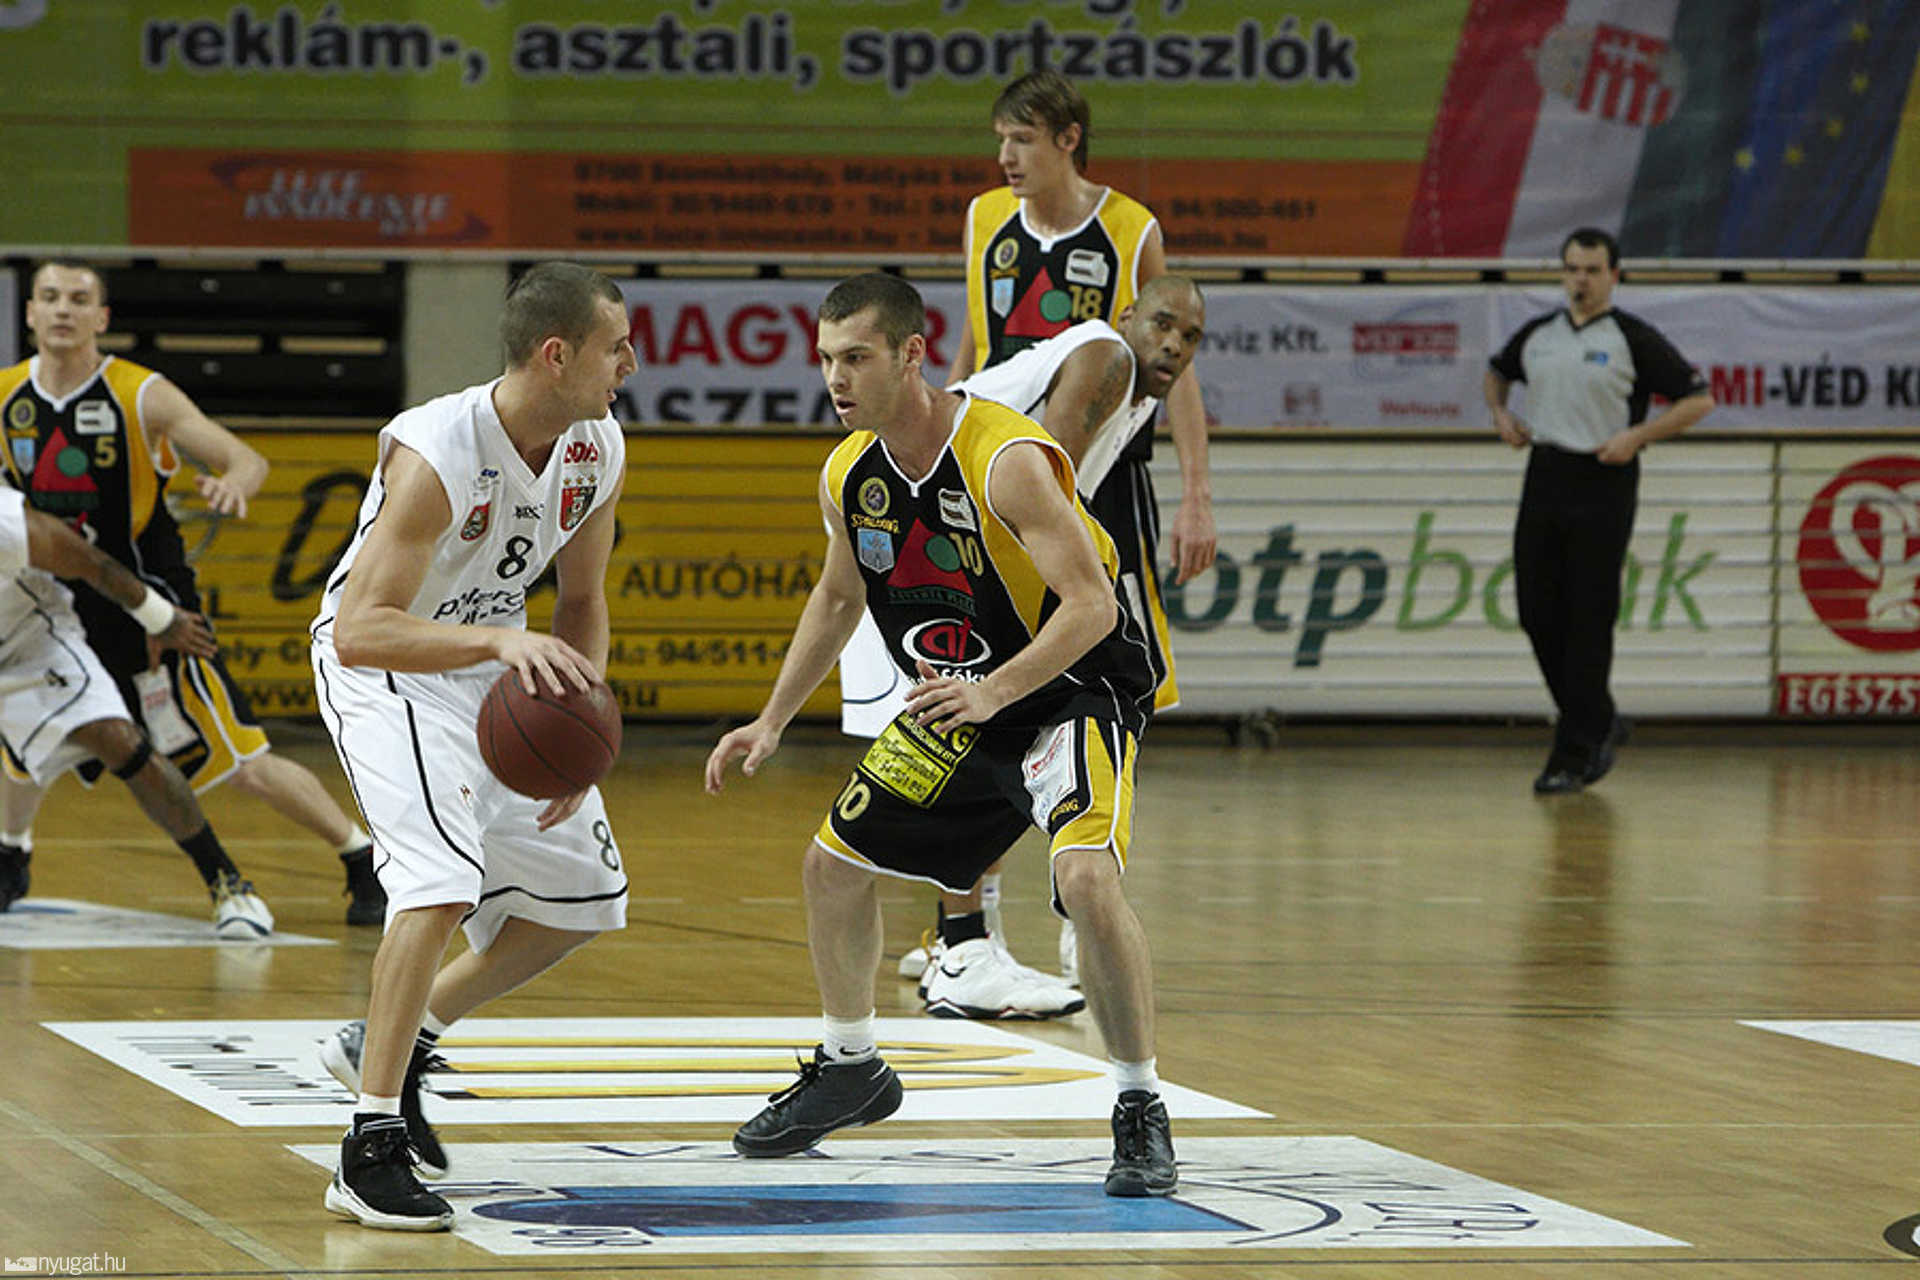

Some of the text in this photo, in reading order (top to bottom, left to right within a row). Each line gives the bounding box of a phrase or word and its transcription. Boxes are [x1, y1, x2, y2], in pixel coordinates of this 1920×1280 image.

[145, 8, 1356, 91] reklám-, asztali, sportzászlók
[1067, 285, 1103, 321] 18
[628, 304, 948, 368] MAGYR
[94, 435, 117, 468] 5
[496, 535, 534, 580] 8
[620, 551, 825, 600] AUTÓHÁ
[949, 532, 984, 577] 10
[592, 819, 620, 873] 8
